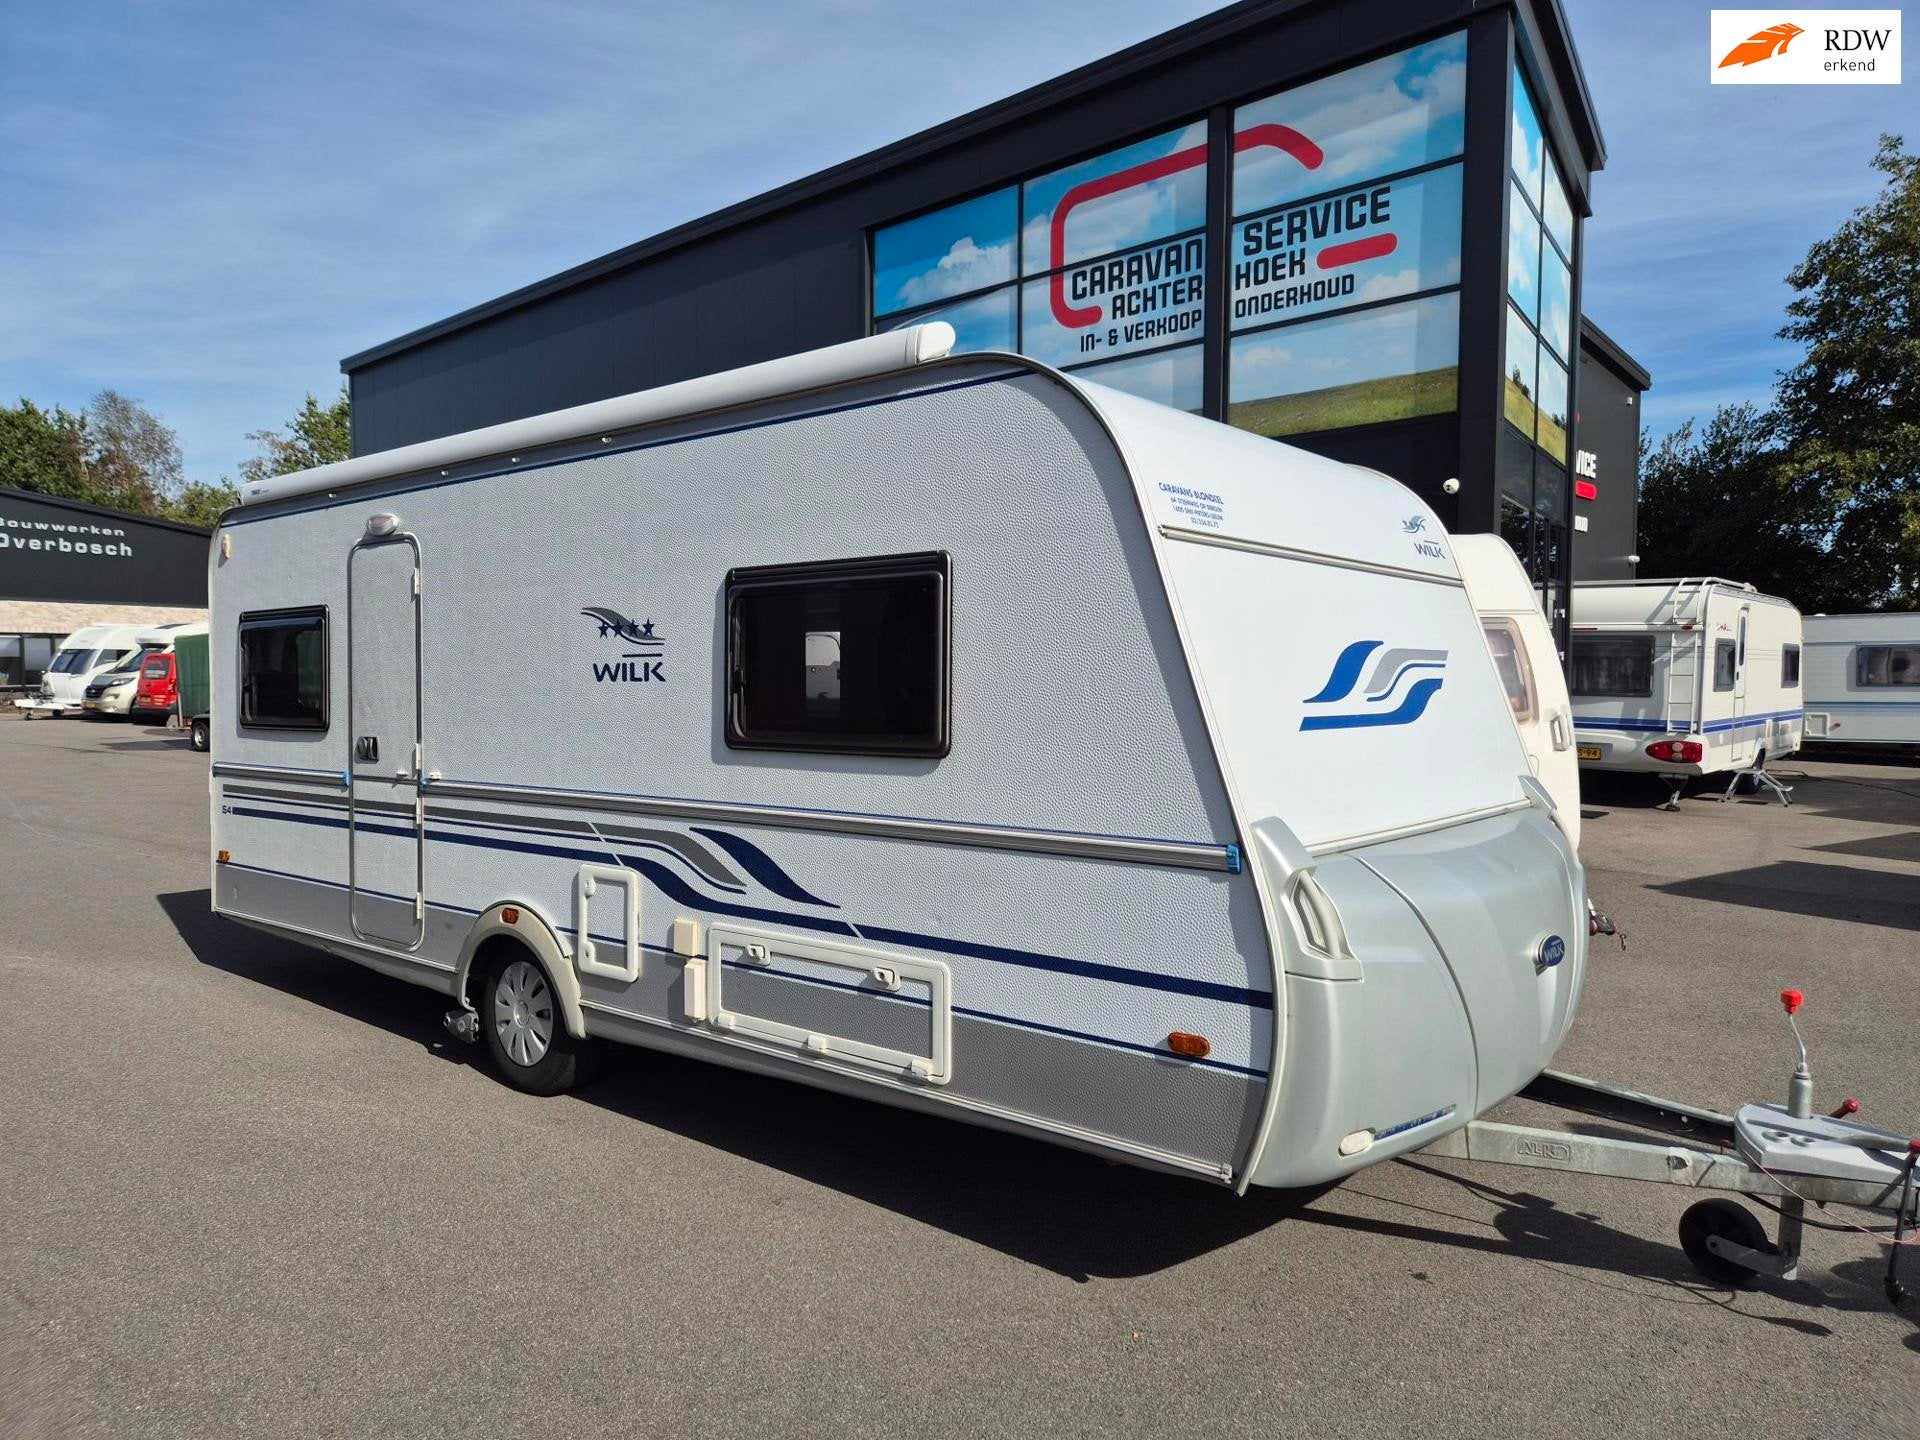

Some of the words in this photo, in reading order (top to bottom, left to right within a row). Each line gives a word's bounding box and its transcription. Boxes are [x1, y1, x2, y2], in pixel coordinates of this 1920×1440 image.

[1072, 239, 1203, 301] CARAVAN
[1243, 186, 1391, 256] SERVICE
[1108, 328, 1119, 346] &
[1124, 309, 1202, 342] VERKOOP
[1235, 273, 1355, 318] ONDERHOUD
[1112, 274, 1203, 320] ACHTER
[1235, 247, 1306, 290] HOEK
[1413, 542, 1446, 560] WILK
[593, 662, 666, 682] WILK
